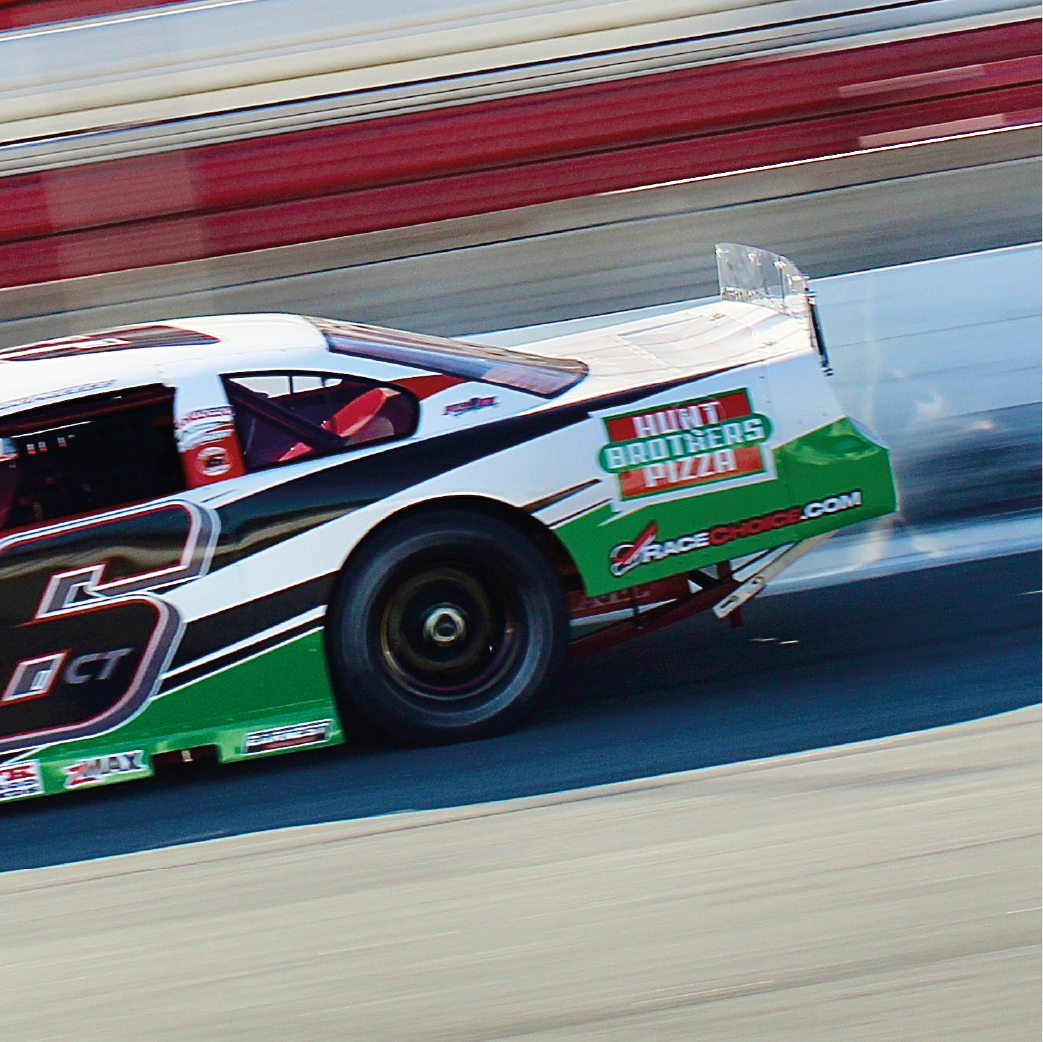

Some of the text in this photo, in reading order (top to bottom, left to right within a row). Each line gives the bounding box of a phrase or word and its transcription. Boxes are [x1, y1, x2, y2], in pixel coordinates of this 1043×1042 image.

[632, 401, 721, 438] HUNT
[603, 418, 766, 469] BROTHERS
[643, 449, 738, 488] PIZZA
[64, 647, 134, 684] CT
